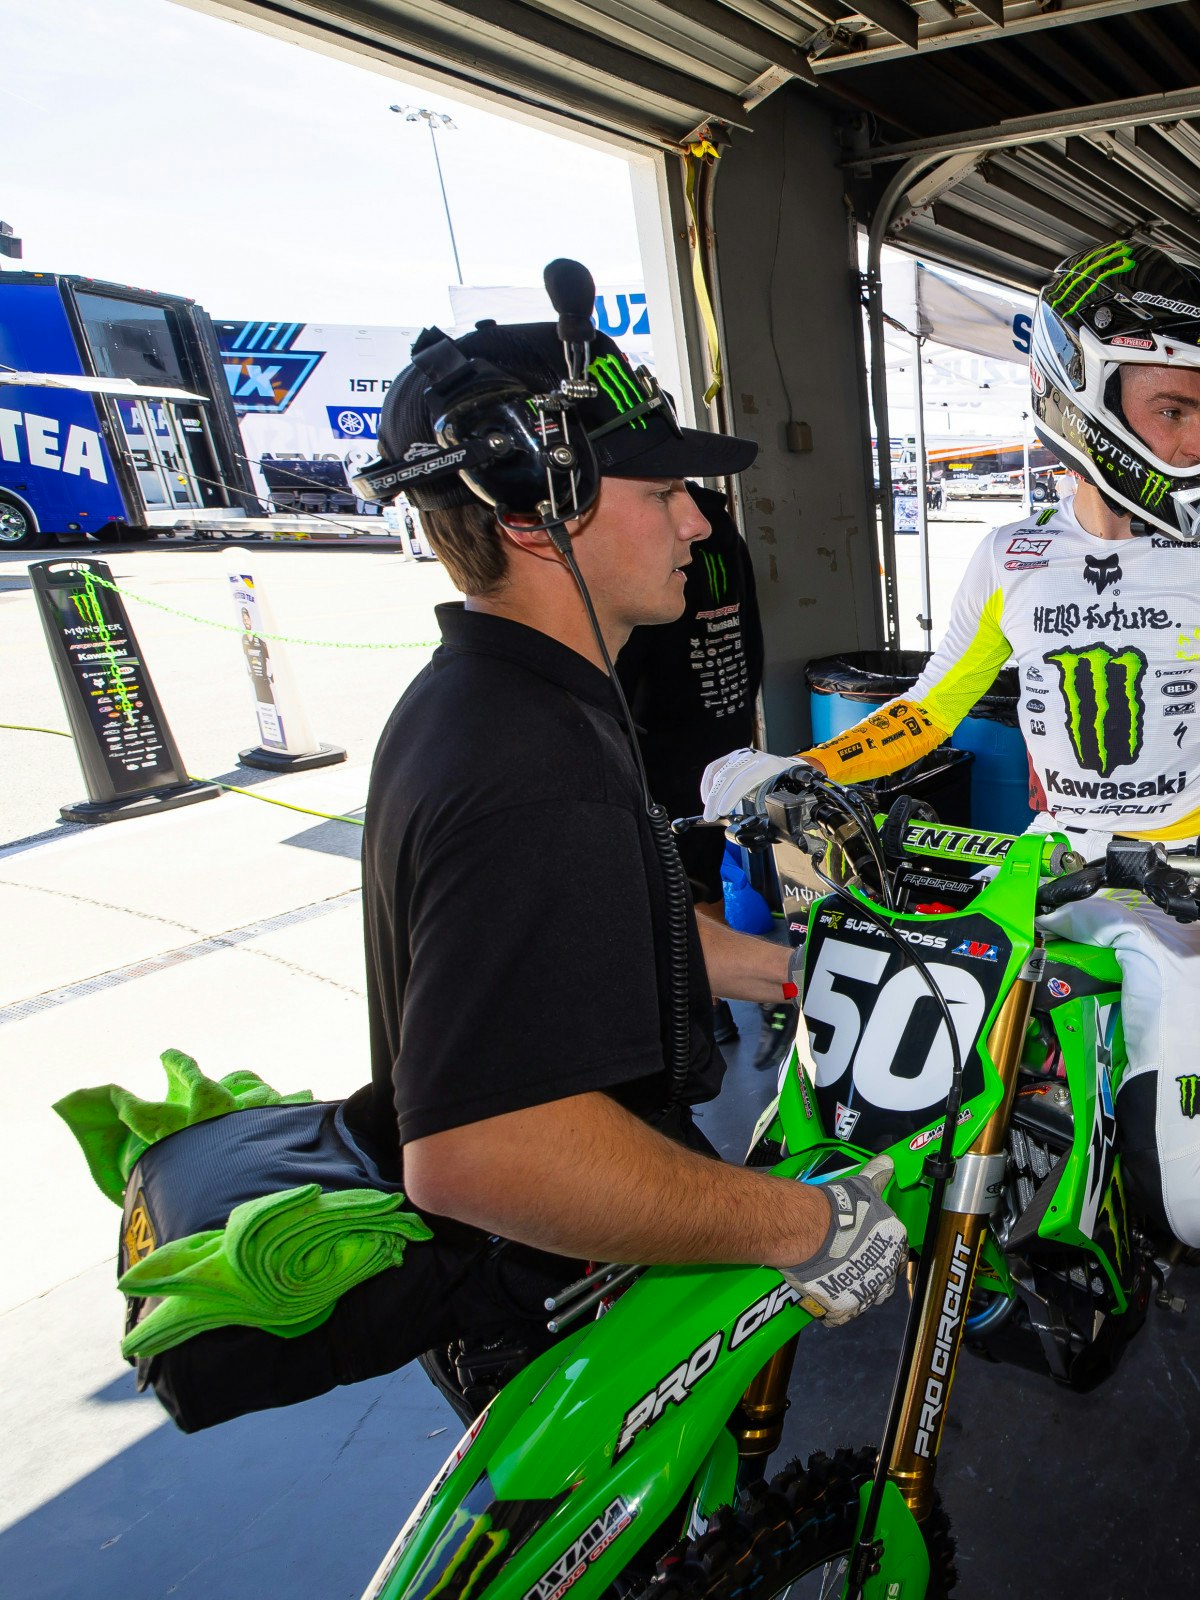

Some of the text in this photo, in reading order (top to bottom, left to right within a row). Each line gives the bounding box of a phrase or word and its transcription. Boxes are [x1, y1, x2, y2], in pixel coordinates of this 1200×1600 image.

[1063, 405, 1144, 479] MONSTER
[1070, 432, 1125, 477] ENERGY
[398, 449, 467, 481] CIRCUIT
[1034, 604, 1081, 636] HELLO
[1167, 685, 1192, 693] BELL
[840, 743, 862, 757] EXCEL
[1045, 768, 1187, 801] Kawasaki
[1088, 803, 1173, 816] CIRCUIT
[901, 825, 1016, 860] ENTHA
[952, 939, 998, 959] AMA
[803, 937, 985, 1112] 50
[816, 1231, 893, 1301] Mechanix
[931, 1233, 973, 1377] CIRCUIT
[617, 1332, 723, 1455] PRO
[914, 1377, 944, 1459] PRO
[589, 1514, 632, 1562] OILS
